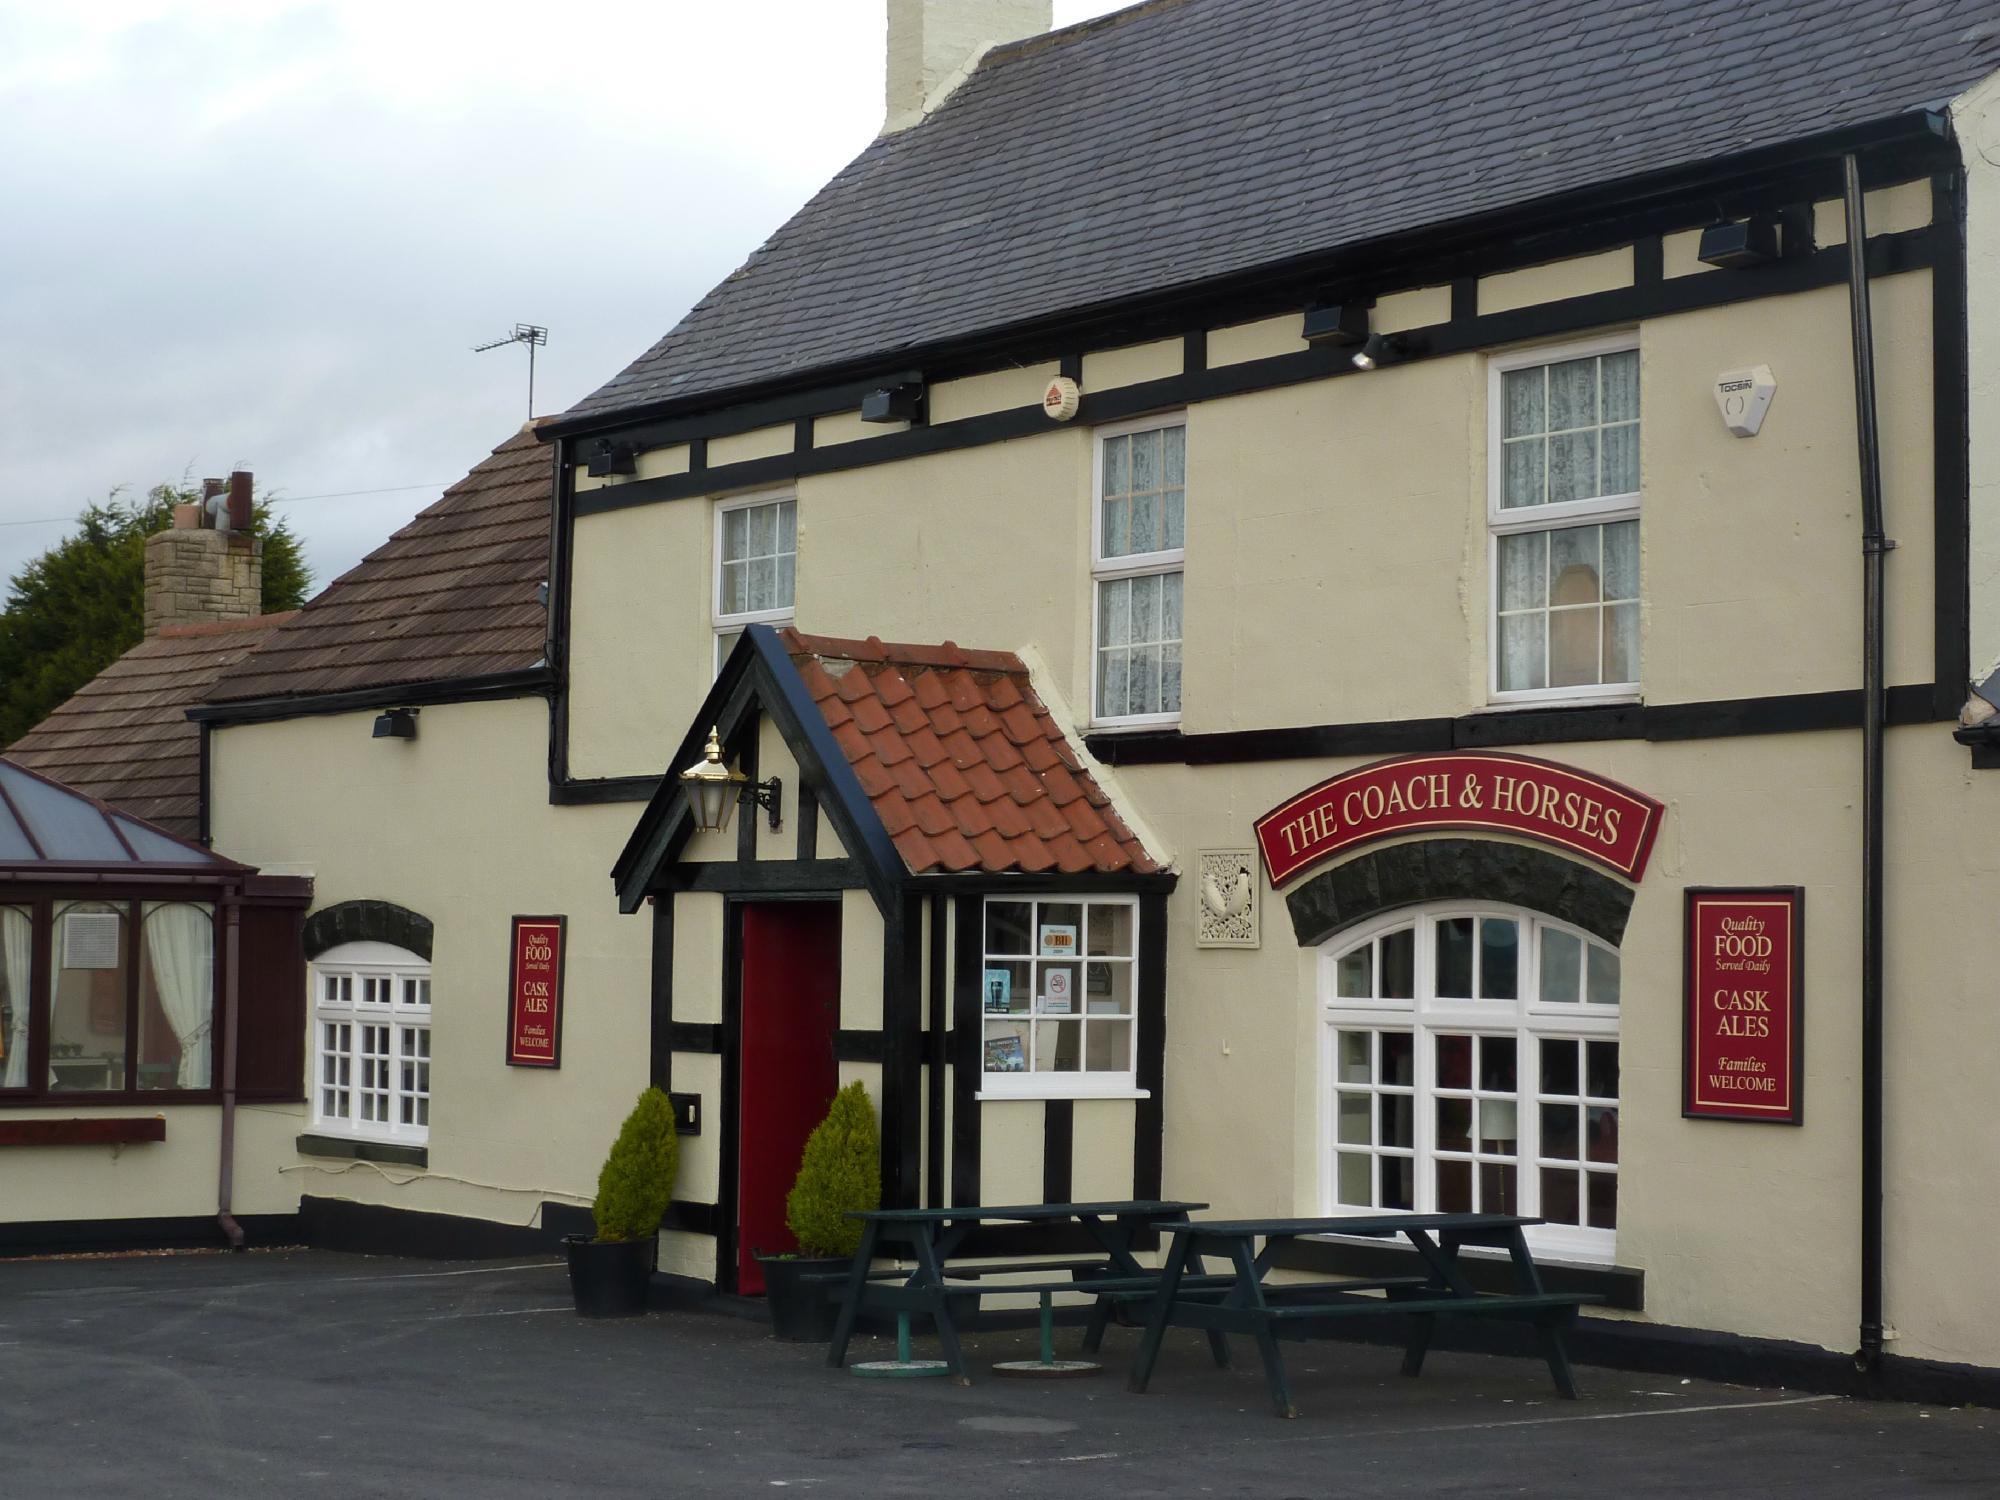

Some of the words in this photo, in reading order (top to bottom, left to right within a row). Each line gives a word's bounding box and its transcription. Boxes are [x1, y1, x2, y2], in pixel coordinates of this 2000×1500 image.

[1280, 802, 1338, 857] THE
[1343, 773, 1451, 827] COACH
[1459, 773, 1484, 809] &
[1492, 775, 1623, 845] HORSES
[1721, 915, 1765, 936] Quality
[529, 934, 548, 947] Quality
[1714, 935, 1772, 957] FOOD
[525, 946, 551, 960] FOOD
[1715, 958, 1744, 971] Served
[1745, 960, 1771, 975] Daily
[524, 981, 548, 996] CASK
[524, 998, 547, 1013] ALES
[1714, 989, 1771, 1012] CASK
[524, 1024, 545, 1035] Families
[1716, 1015, 1769, 1038] ALES
[520, 1037, 549, 1048] WELCOME
[1718, 1056, 1767, 1073] Families
[1709, 1074, 1776, 1092] WELCOME
